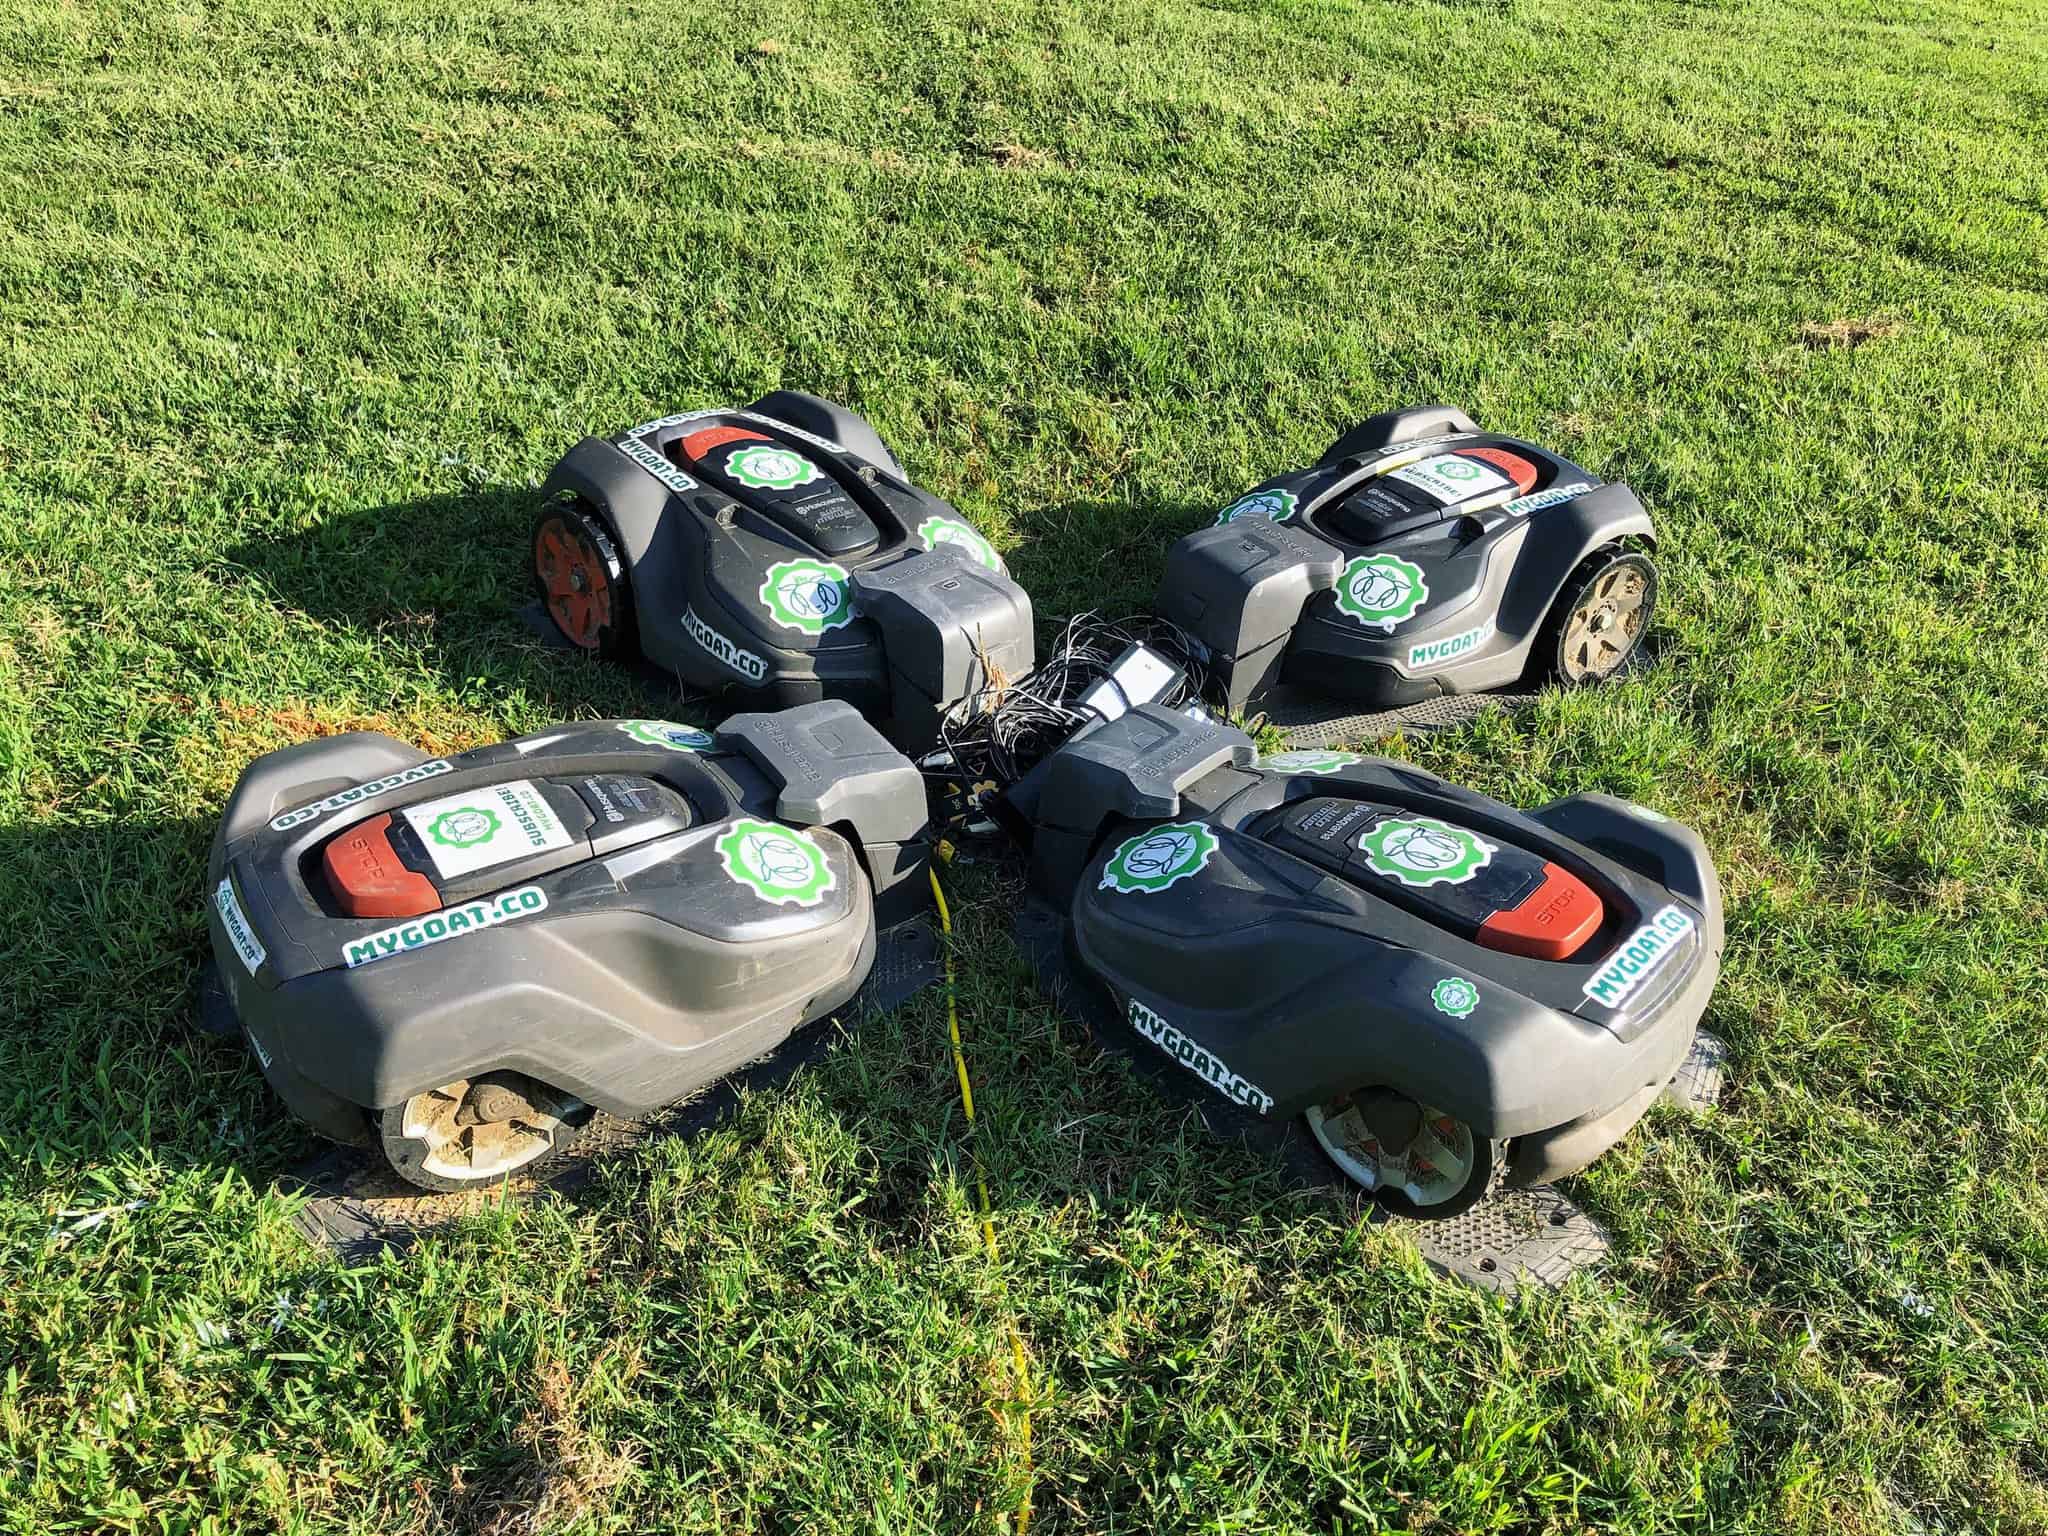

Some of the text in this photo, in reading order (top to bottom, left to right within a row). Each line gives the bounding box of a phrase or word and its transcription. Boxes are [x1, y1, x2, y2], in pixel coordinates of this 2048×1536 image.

[623, 438, 691, 489] MYGOAT.CO
[276, 762, 446, 828] MYGOAT.CO
[495, 786, 547, 846] SUBSCRIBE!
[352, 837, 385, 881] STOP
[225, 907, 256, 960] MYGOAT.CO
[350, 891, 542, 965] MYGOAT.CO
[1536, 888, 1576, 926] STOP
[1590, 911, 1687, 1003] MYGOAT.CO
[1130, 1004, 1264, 1109] MYGOAT.CO
